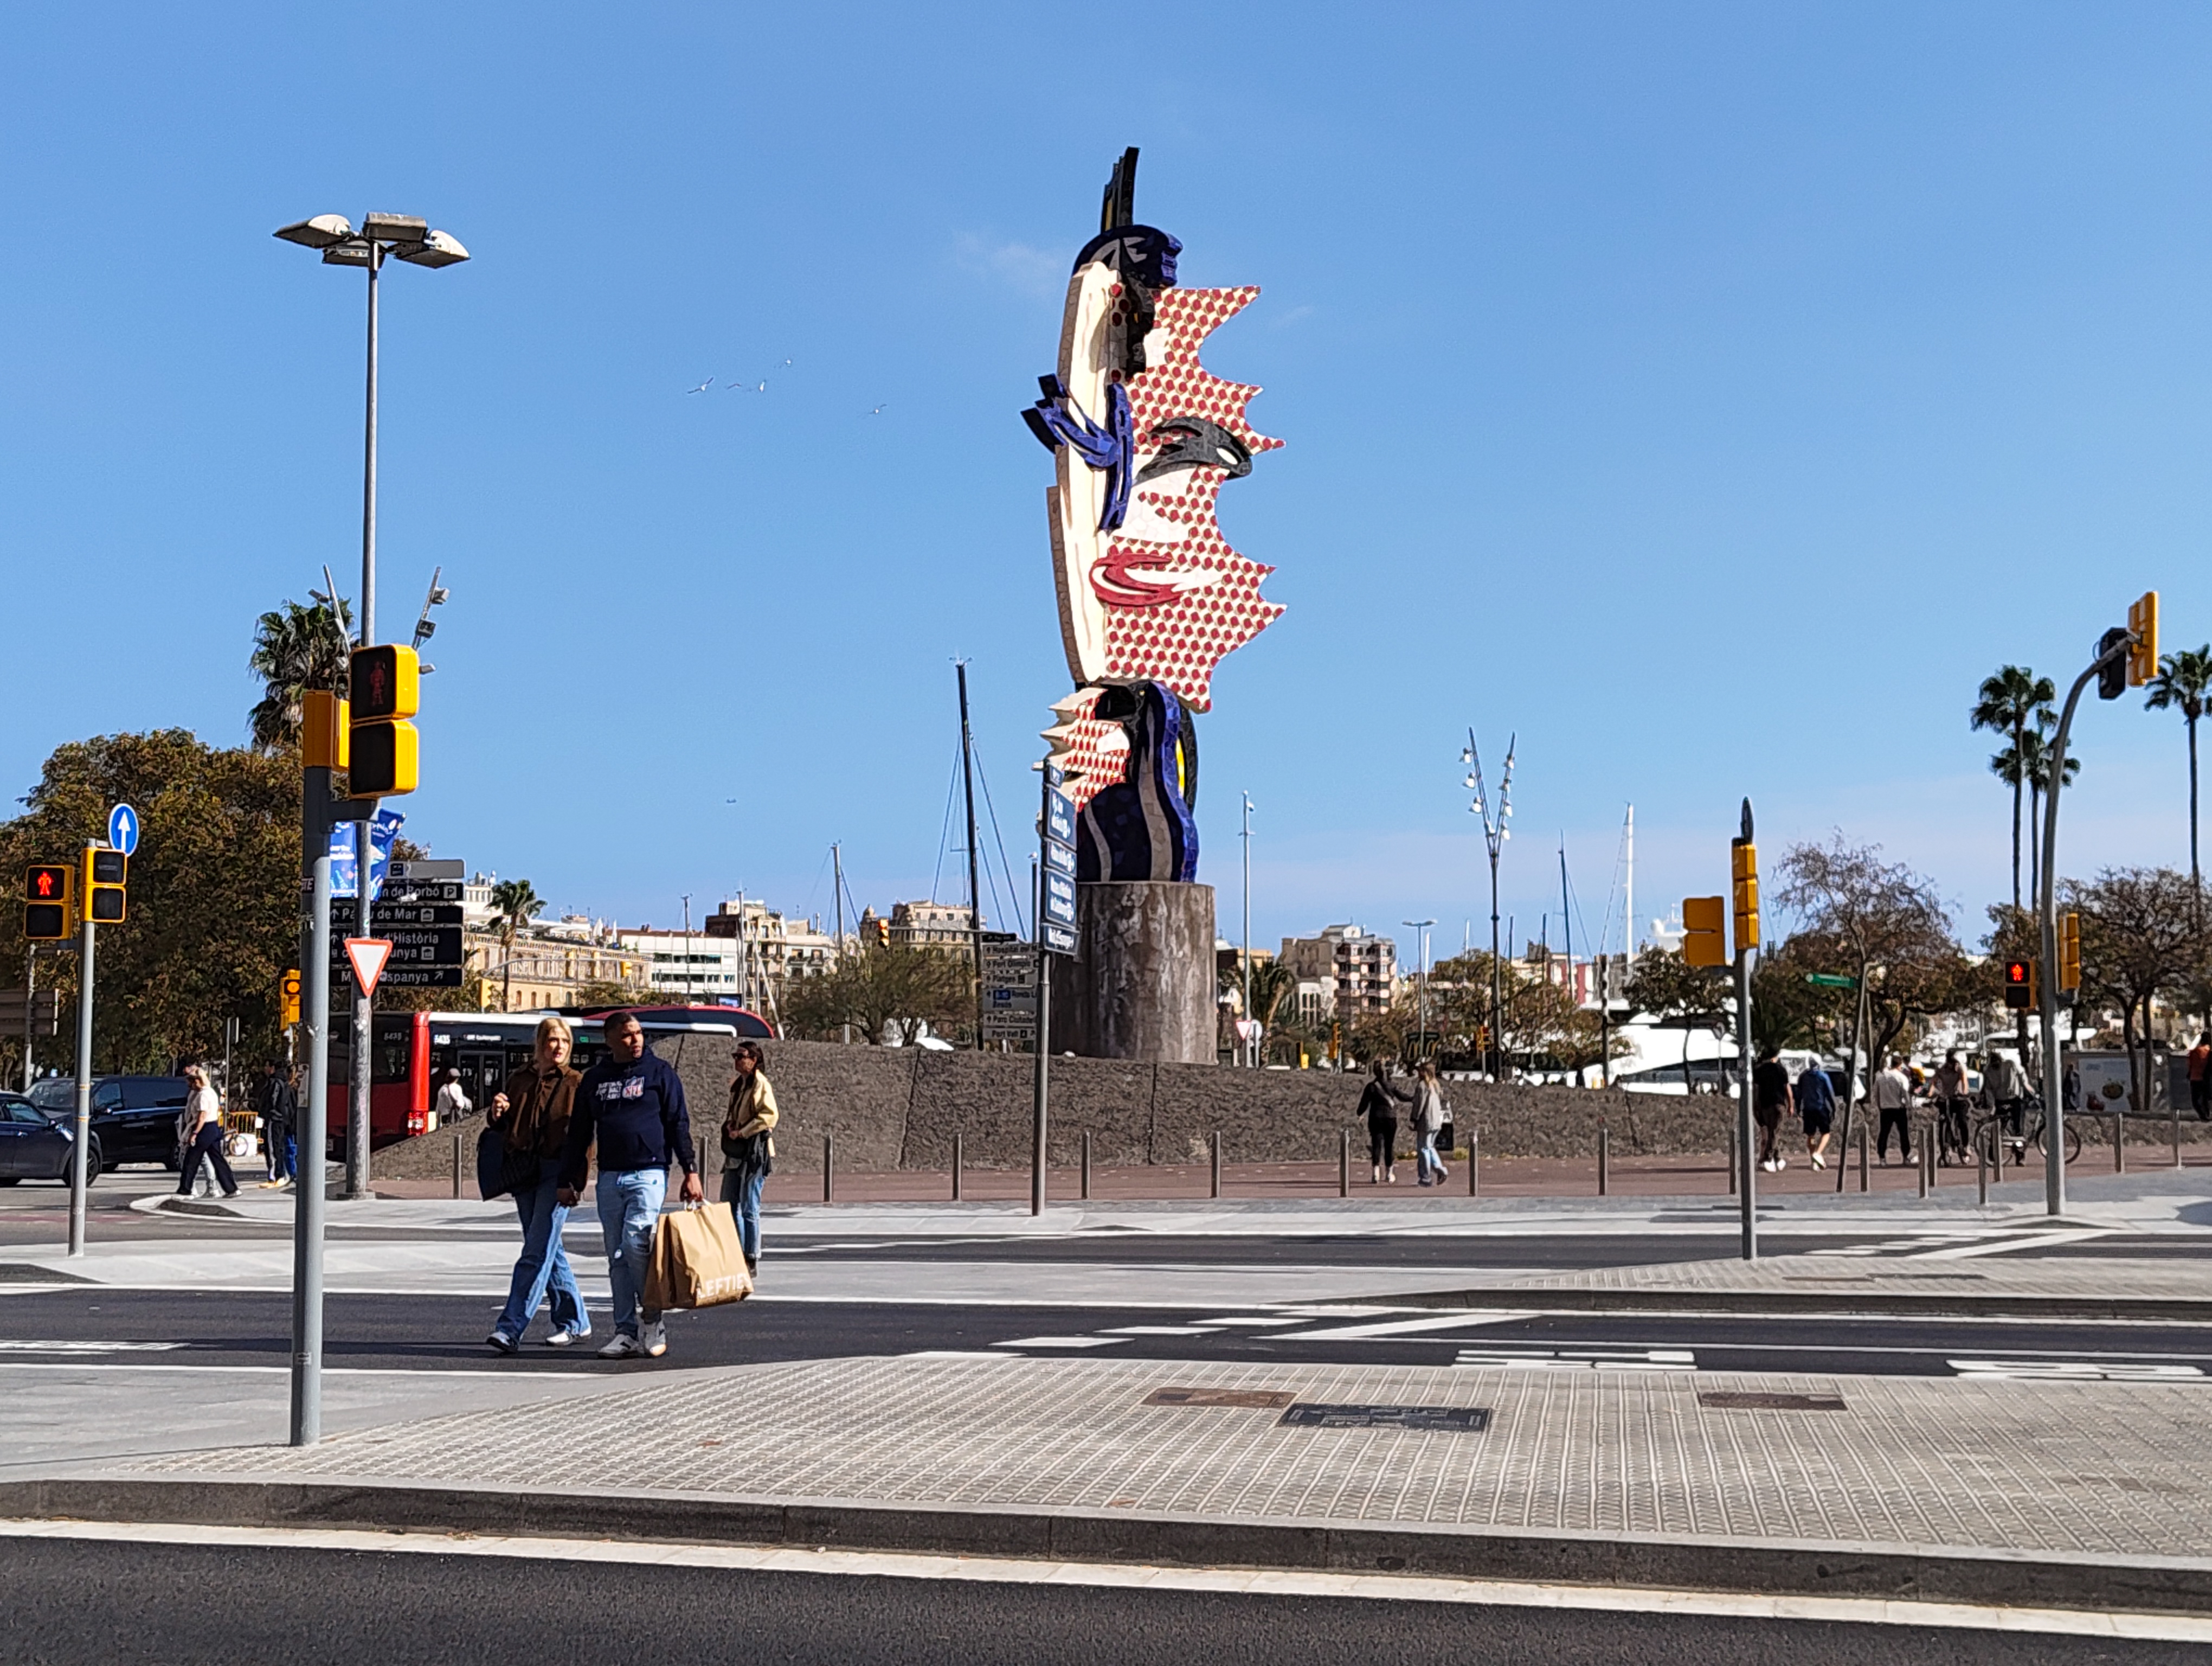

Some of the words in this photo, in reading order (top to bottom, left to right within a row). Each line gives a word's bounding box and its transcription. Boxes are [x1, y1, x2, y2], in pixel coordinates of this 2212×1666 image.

[391, 885, 404, 896] de
[377, 906, 391, 919] de
[395, 908, 417, 919] Mar
